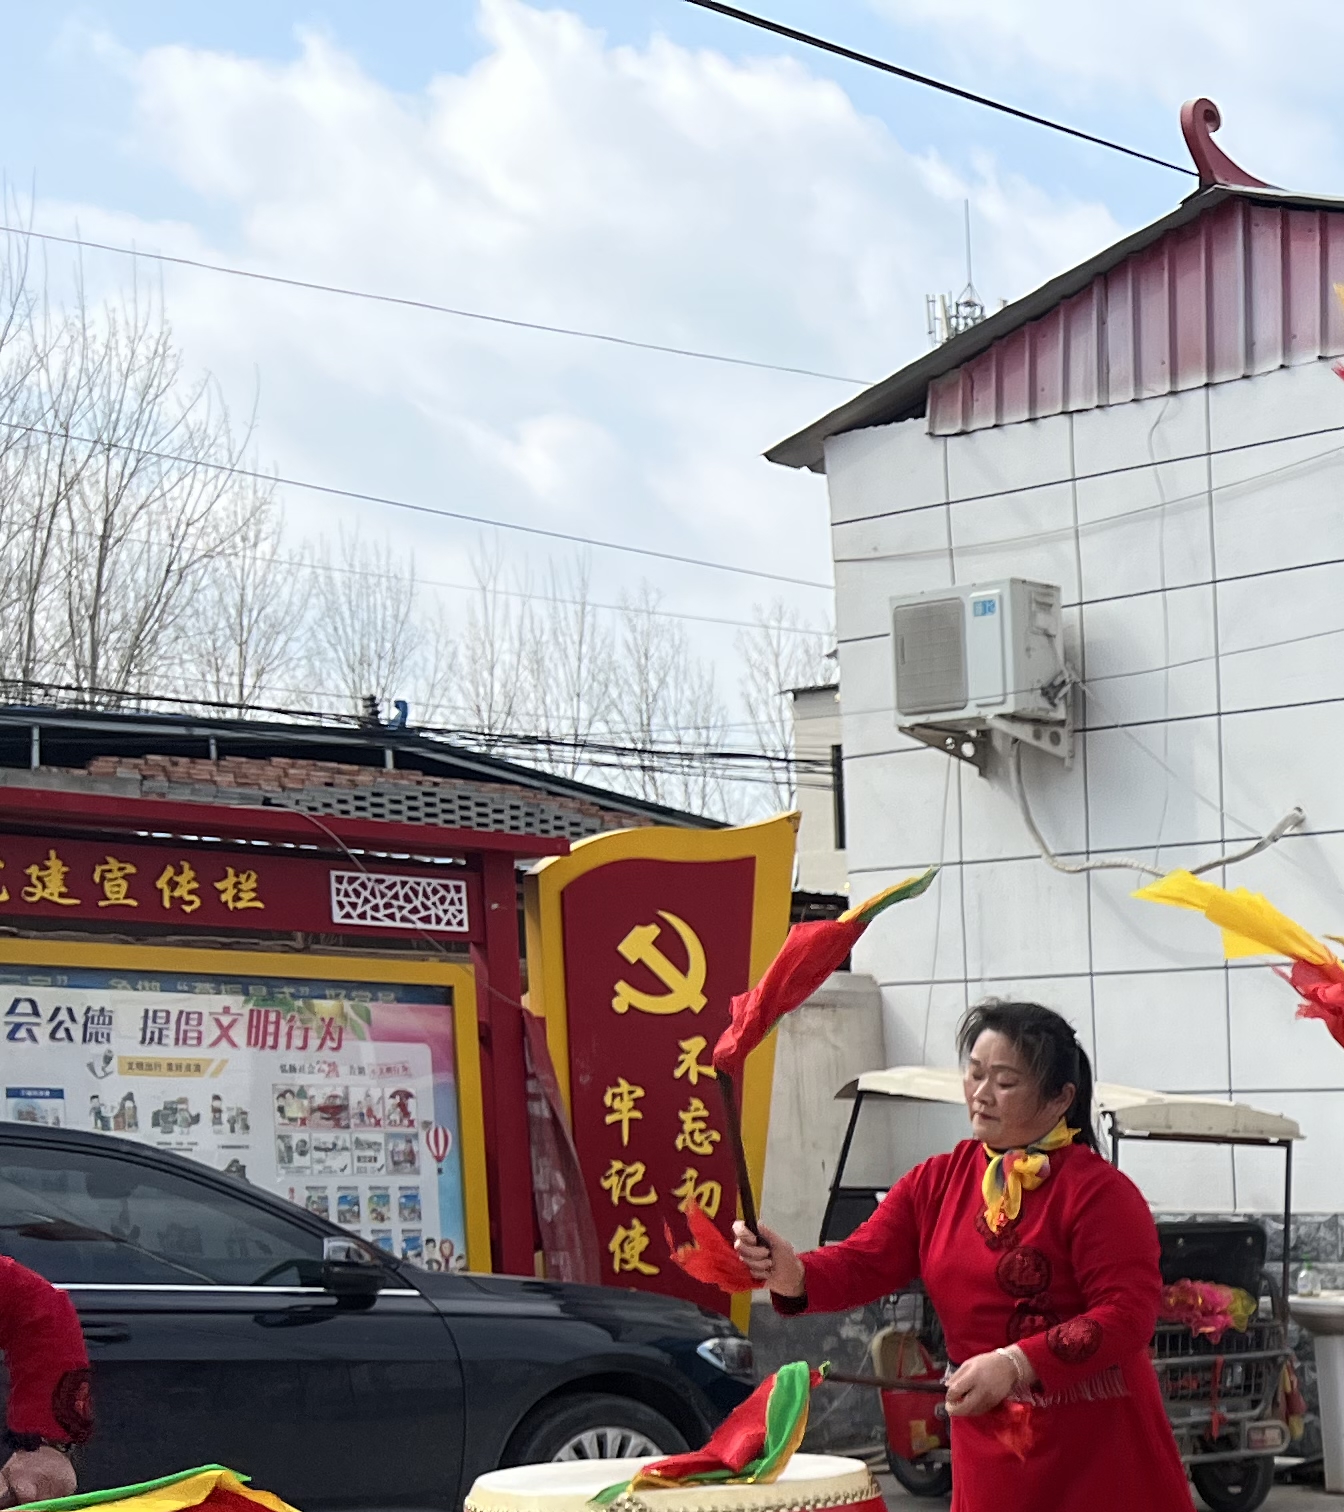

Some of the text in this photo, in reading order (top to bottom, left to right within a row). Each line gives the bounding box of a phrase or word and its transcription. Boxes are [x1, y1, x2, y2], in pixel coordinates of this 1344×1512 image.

[0, 849, 265, 914] 建宣传栏
[139, 1004, 345, 1053] 提倡文明行为
[600, 1077, 661, 1291] 牢记使
[671, 1035, 722, 1263] 不忘初
